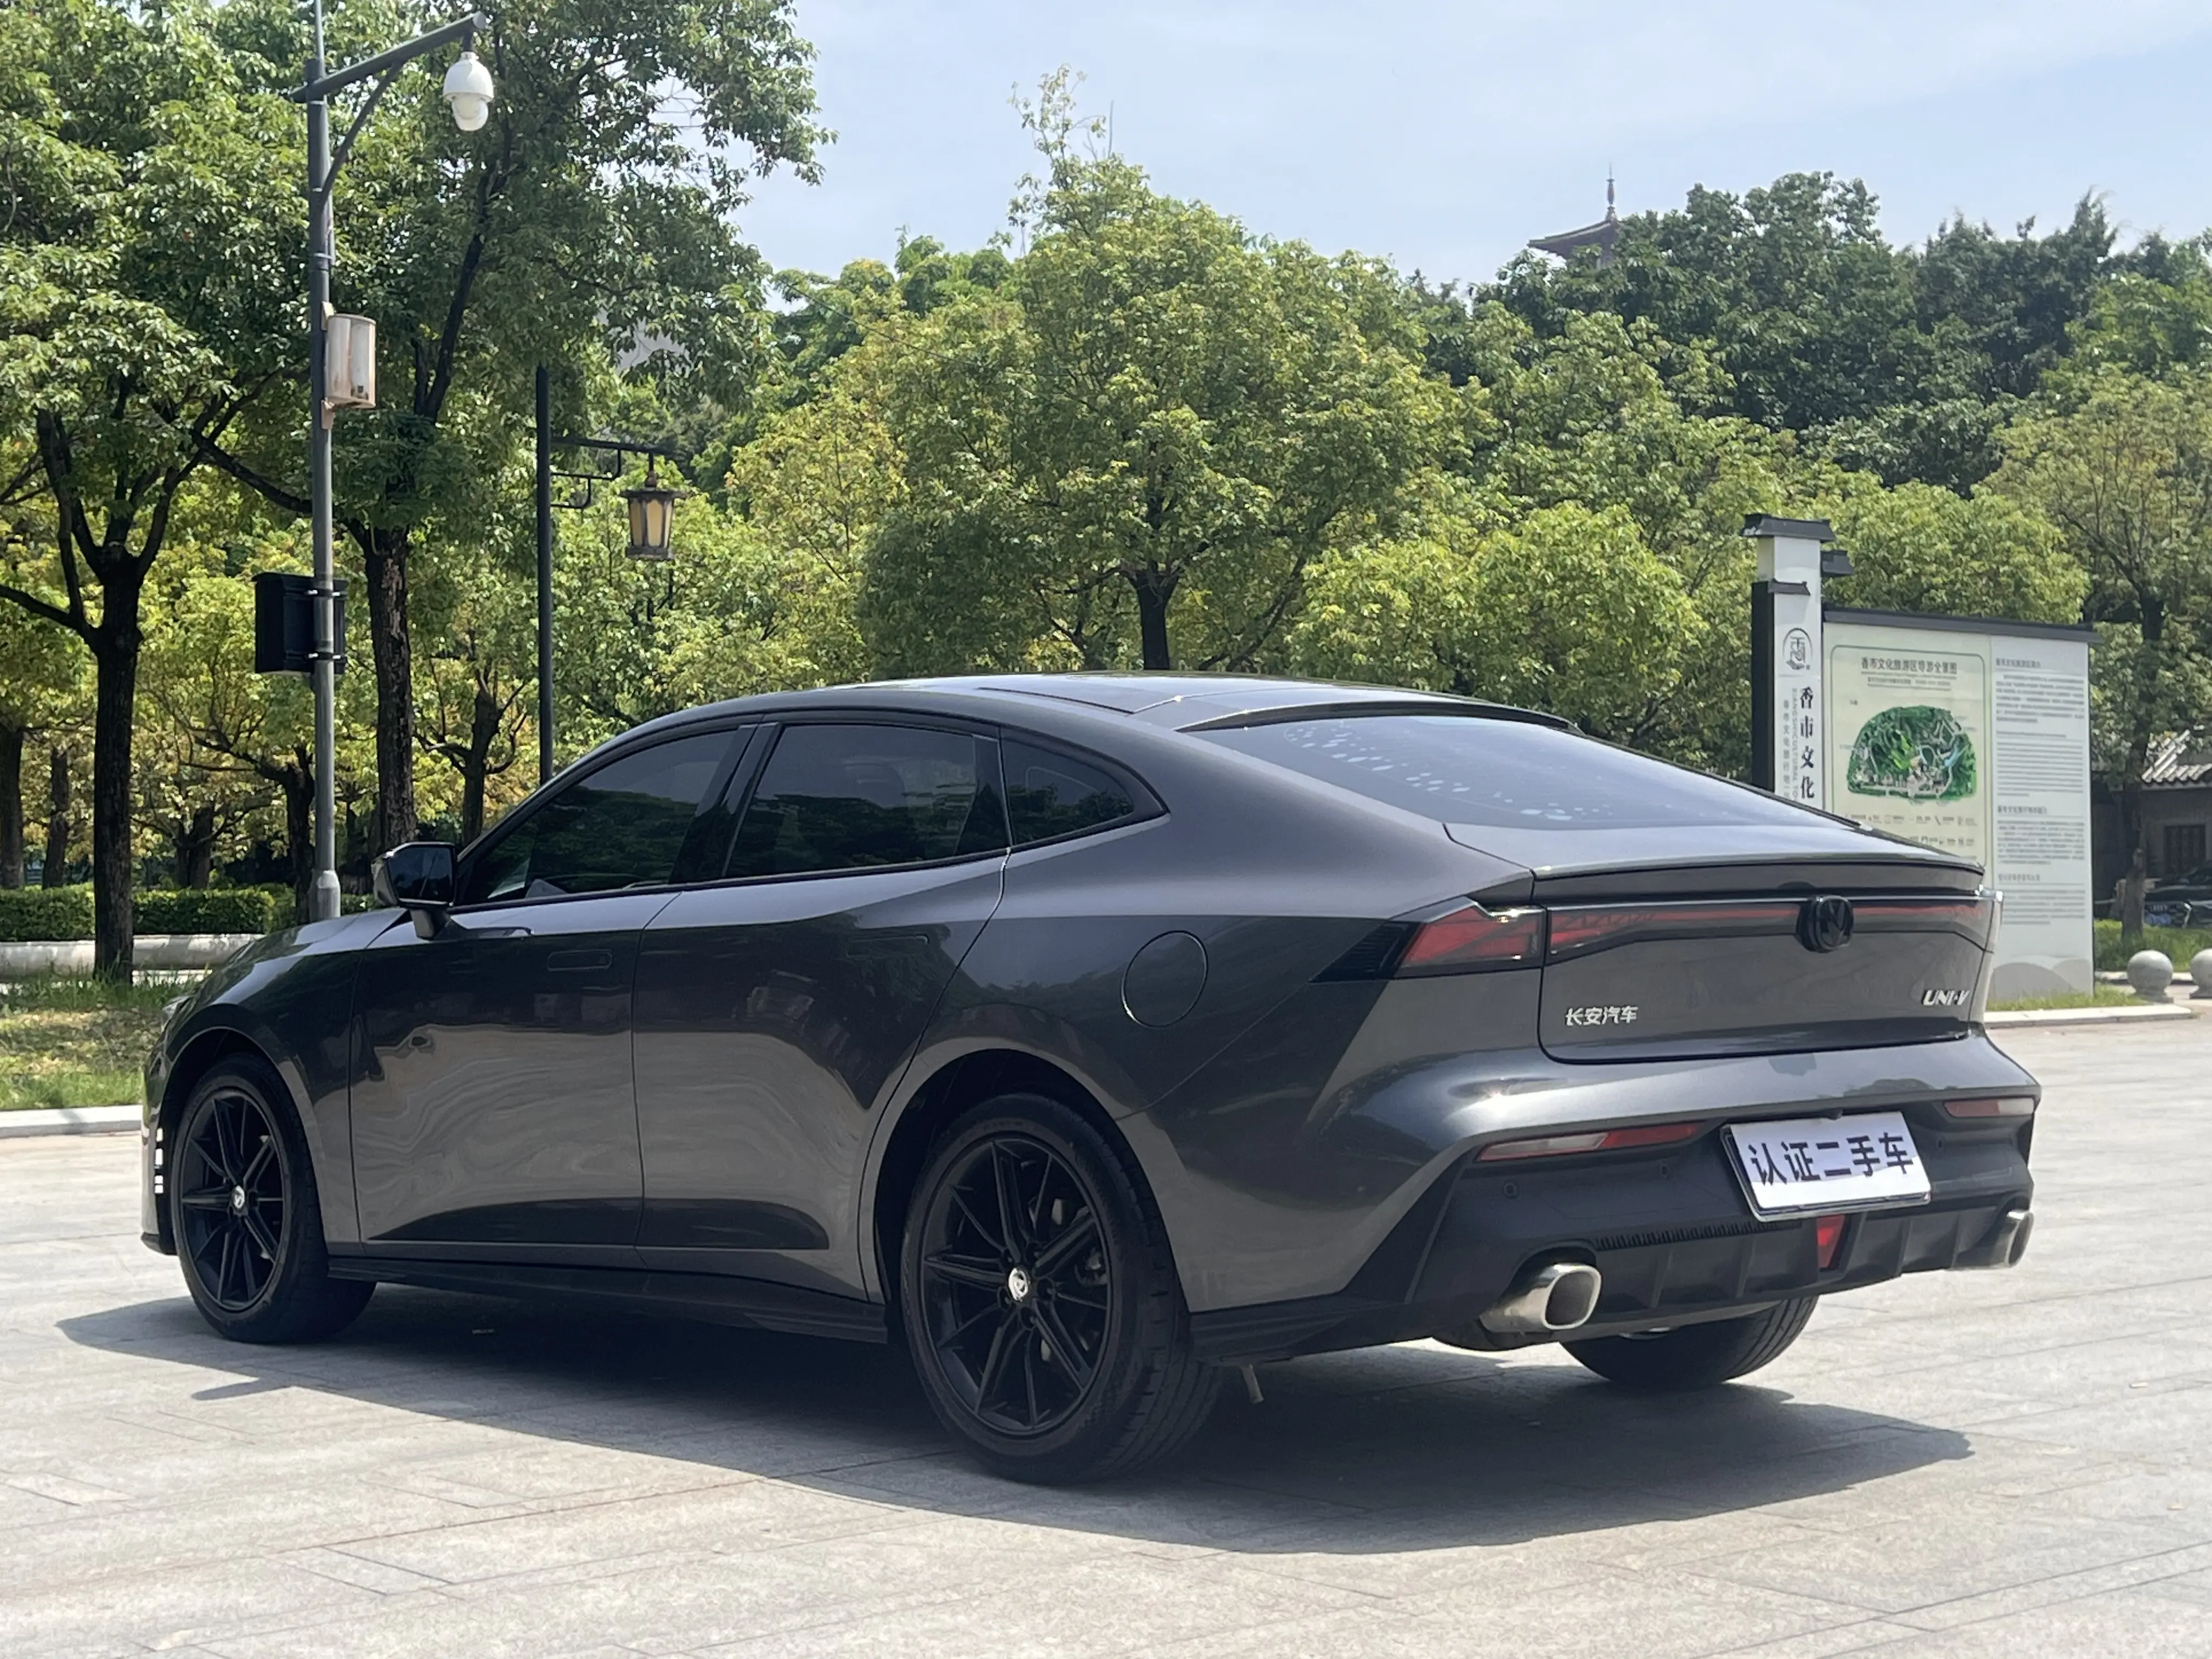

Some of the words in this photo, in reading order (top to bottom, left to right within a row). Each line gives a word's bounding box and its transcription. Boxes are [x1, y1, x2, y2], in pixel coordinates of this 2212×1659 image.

[1801, 686, 1815, 799] 香市文化
[1565, 1006, 1639, 1026] 长安汽车
[1921, 989, 1971, 1006] UNI-V
[1748, 1132, 1914, 1186] 认证二手车
